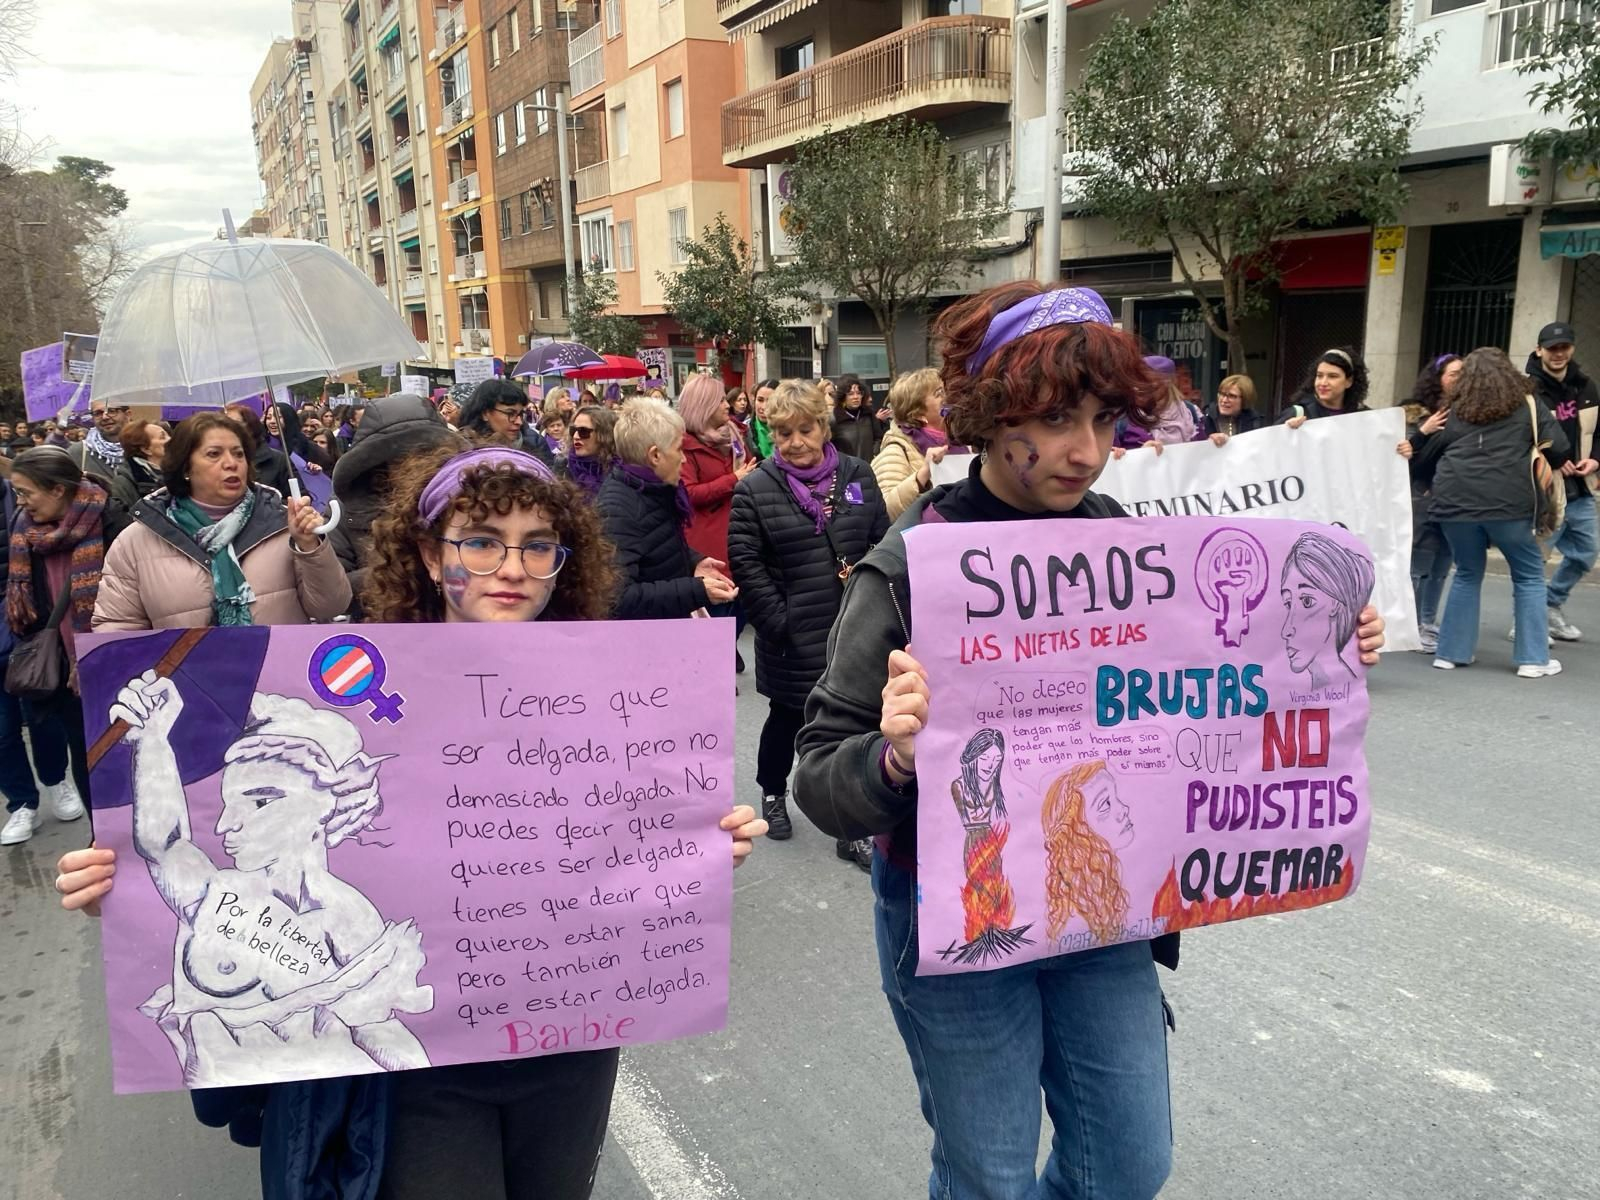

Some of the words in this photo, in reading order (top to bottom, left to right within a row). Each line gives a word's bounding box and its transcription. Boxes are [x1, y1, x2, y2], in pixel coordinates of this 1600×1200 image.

[960, 543, 1176, 624] SOMOS
[960, 633, 1002, 665] LAS
[1014, 628, 1081, 663] NIETAS
[1090, 625, 1112, 648] DE
[1117, 623, 1148, 646] LAS
[464, 673, 586, 719] Tienes
[610, 687, 669, 728] que
[976, 708, 1004, 724] que
[1013, 705, 1033, 718] las
[1038, 703, 1083, 718] mujeres
[1032, 679, 1086, 700] deseo
[1096, 664, 1268, 727] BRUJAS
[442, 743, 485, 766] ser
[507, 737, 616, 776] delgada,
[626, 740, 676, 772] pero
[689, 732, 719, 752] no
[1012, 742, 1043, 754] poder
[1048, 740, 1066, 753] que
[1070, 735, 1083, 745] los
[1090, 733, 1135, 745] hombres,
[1139, 733, 1159, 743] sino
[1013, 724, 1052, 741] tengan
[1057, 718, 1081, 733] más
[1175, 727, 1242, 774] QUE
[1262, 708, 1330, 772] NO
[1014, 757, 1032, 771] que
[1038, 751, 1073, 765] tengan
[1078, 748, 1099, 760] más
[1106, 748, 1132, 761] poder
[1138, 745, 1161, 755] sobre
[1121, 760, 1132, 770] sí
[446, 784, 569, 809] demasiado
[584, 778, 681, 812] delgada.
[685, 762, 718, 794] No
[1186, 775, 1358, 833] PUDISTEIS
[448, 818, 539, 849] puedes
[555, 816, 615, 850] decir
[628, 812, 675, 843] que
[451, 859, 545, 889] quieres
[558, 857, 600, 874] ser
[605, 838, 704, 872] delgada,
[1180, 843, 1344, 903] QUEMAR
[453, 896, 527, 923] tienes
[541, 897, 580, 922] que
[590, 885, 640, 907] decir
[655, 880, 702, 909] que
[215, 891, 249, 918] Por
[258, 906, 273, 928] la
[279, 918, 334, 967] libertad
[216, 920, 236, 940] de
[248, 931, 310, 976] belleza
[455, 936, 549, 964] quieres
[565, 923, 626, 946] estar
[642, 910, 703, 932] sana,
[457, 971, 506, 994] pero
[522, 951, 621, 983] también
[641, 937, 705, 963] tienes
[458, 1002, 509, 1029] que
[526, 988, 602, 1013] estar
[616, 967, 711, 1005] delgada.
[498, 1013, 636, 1054] Barbie
